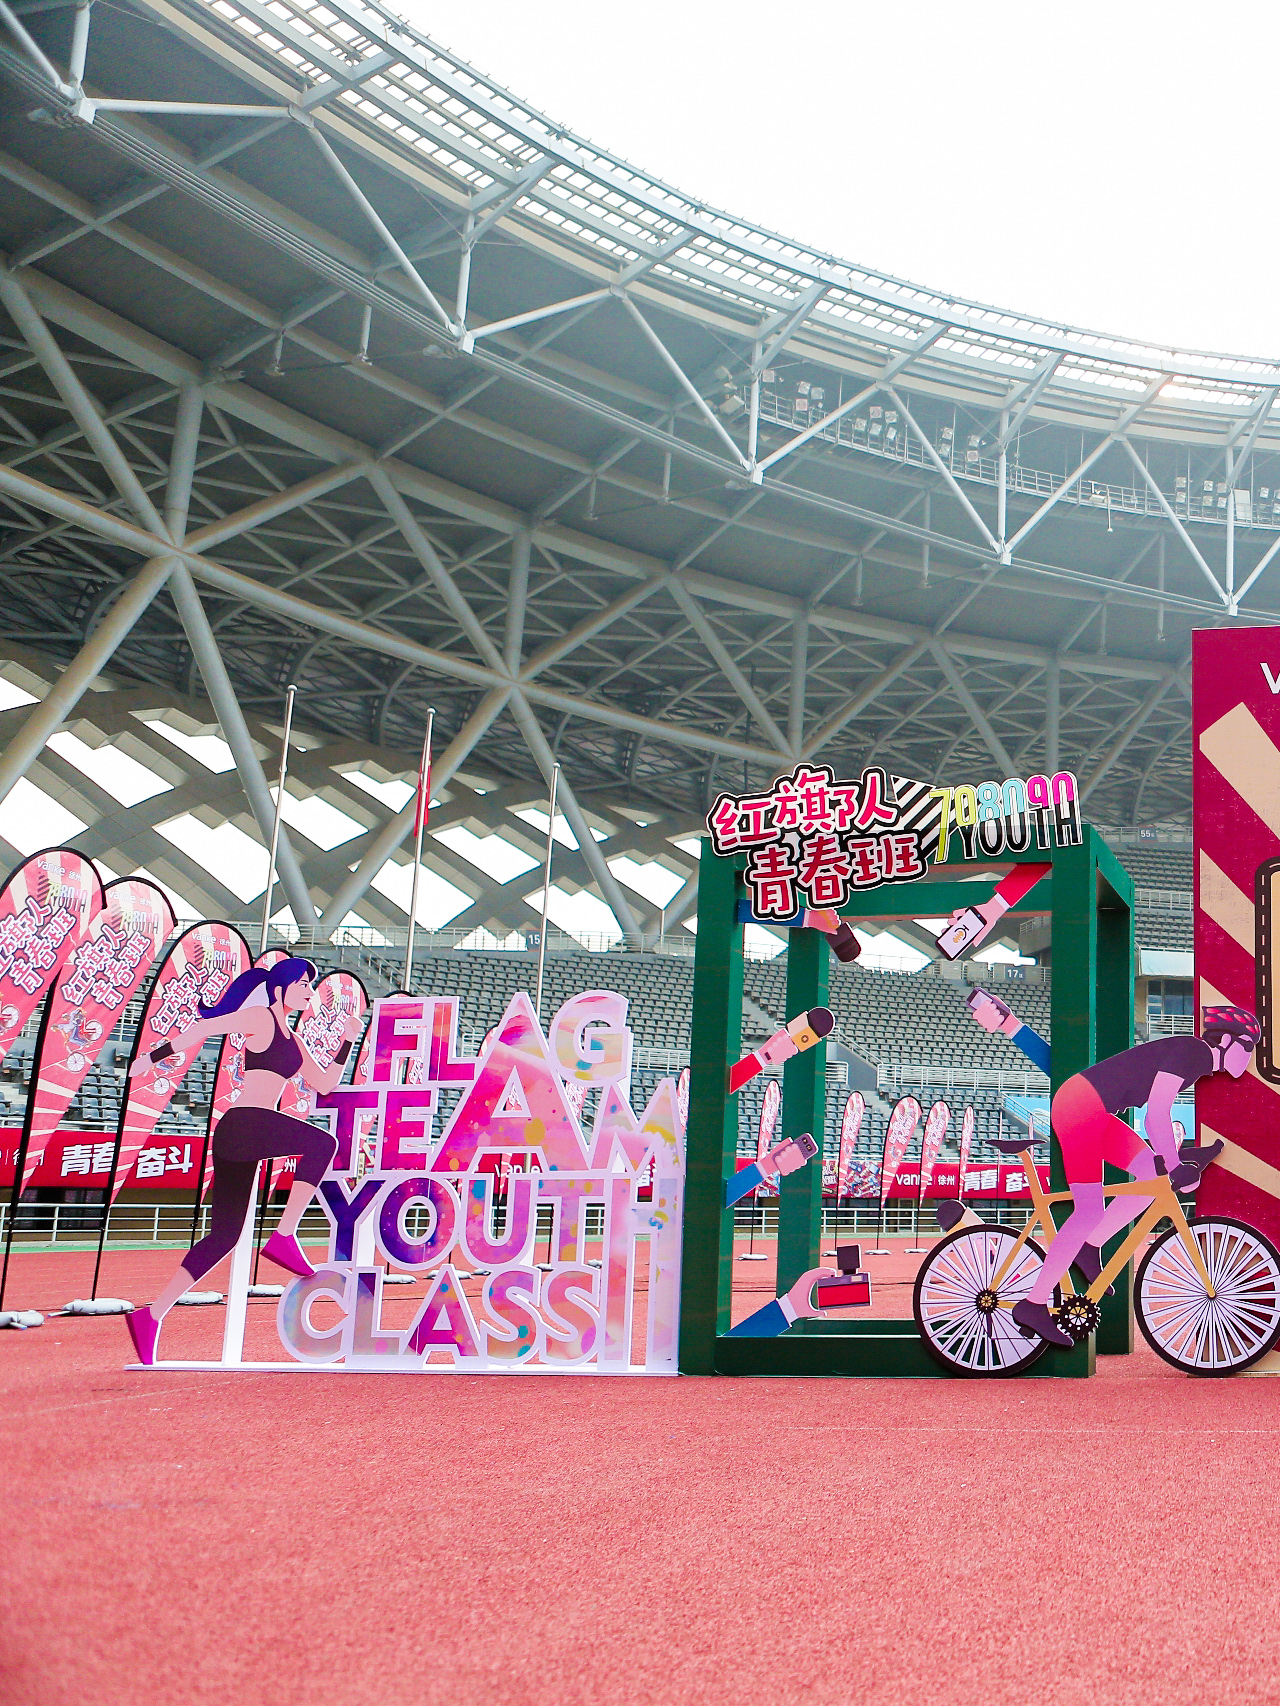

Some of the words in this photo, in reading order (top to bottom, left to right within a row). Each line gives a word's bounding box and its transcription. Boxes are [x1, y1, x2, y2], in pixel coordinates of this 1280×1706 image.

[958, 801, 1080, 858] YOUTH
[751, 836, 921, 912] 青春班
[136, 1143, 194, 1179] 奋斗
[938, 1174, 955, 1186] 徐州
[964, 1168, 998, 1193] 青春
[277, 1263, 602, 1366] CLASS
